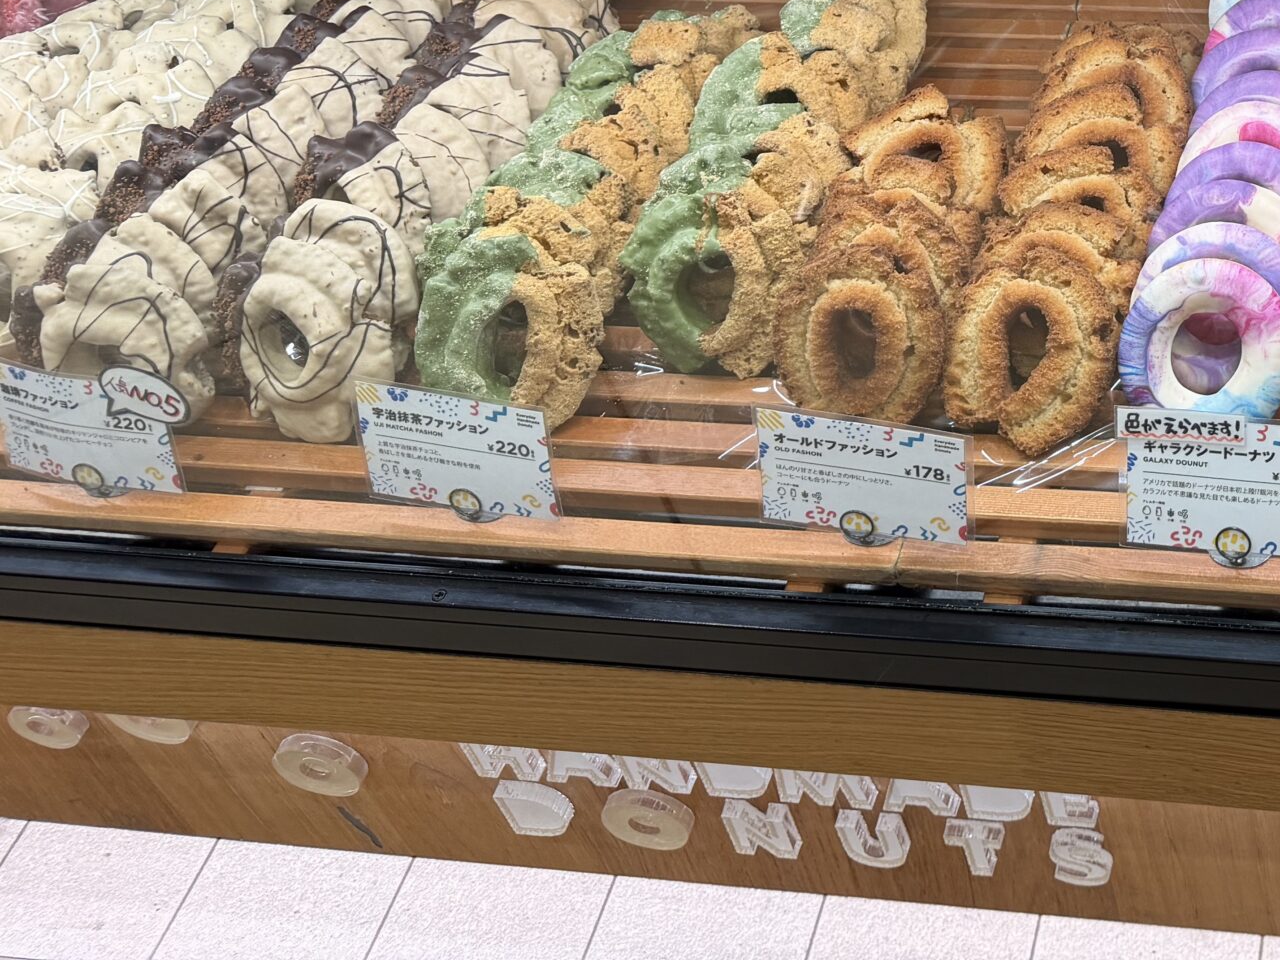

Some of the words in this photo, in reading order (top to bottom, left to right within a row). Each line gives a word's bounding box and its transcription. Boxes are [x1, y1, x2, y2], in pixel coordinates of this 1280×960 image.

[372, 407, 489, 435] 宇治抹茶ファッション
[373, 421, 385, 430] UJI
[385, 423, 414, 434] MATCHA
[774, 433, 898, 459] オールドファッション
[774, 445, 790, 454] OLD
[792, 447, 823, 458] FASHON
[1144, 440, 1275, 463] ギャラクシードーナツ
[1143, 456, 1174, 466] GALAXY
[1175, 459, 1209, 468] DOUNUT
